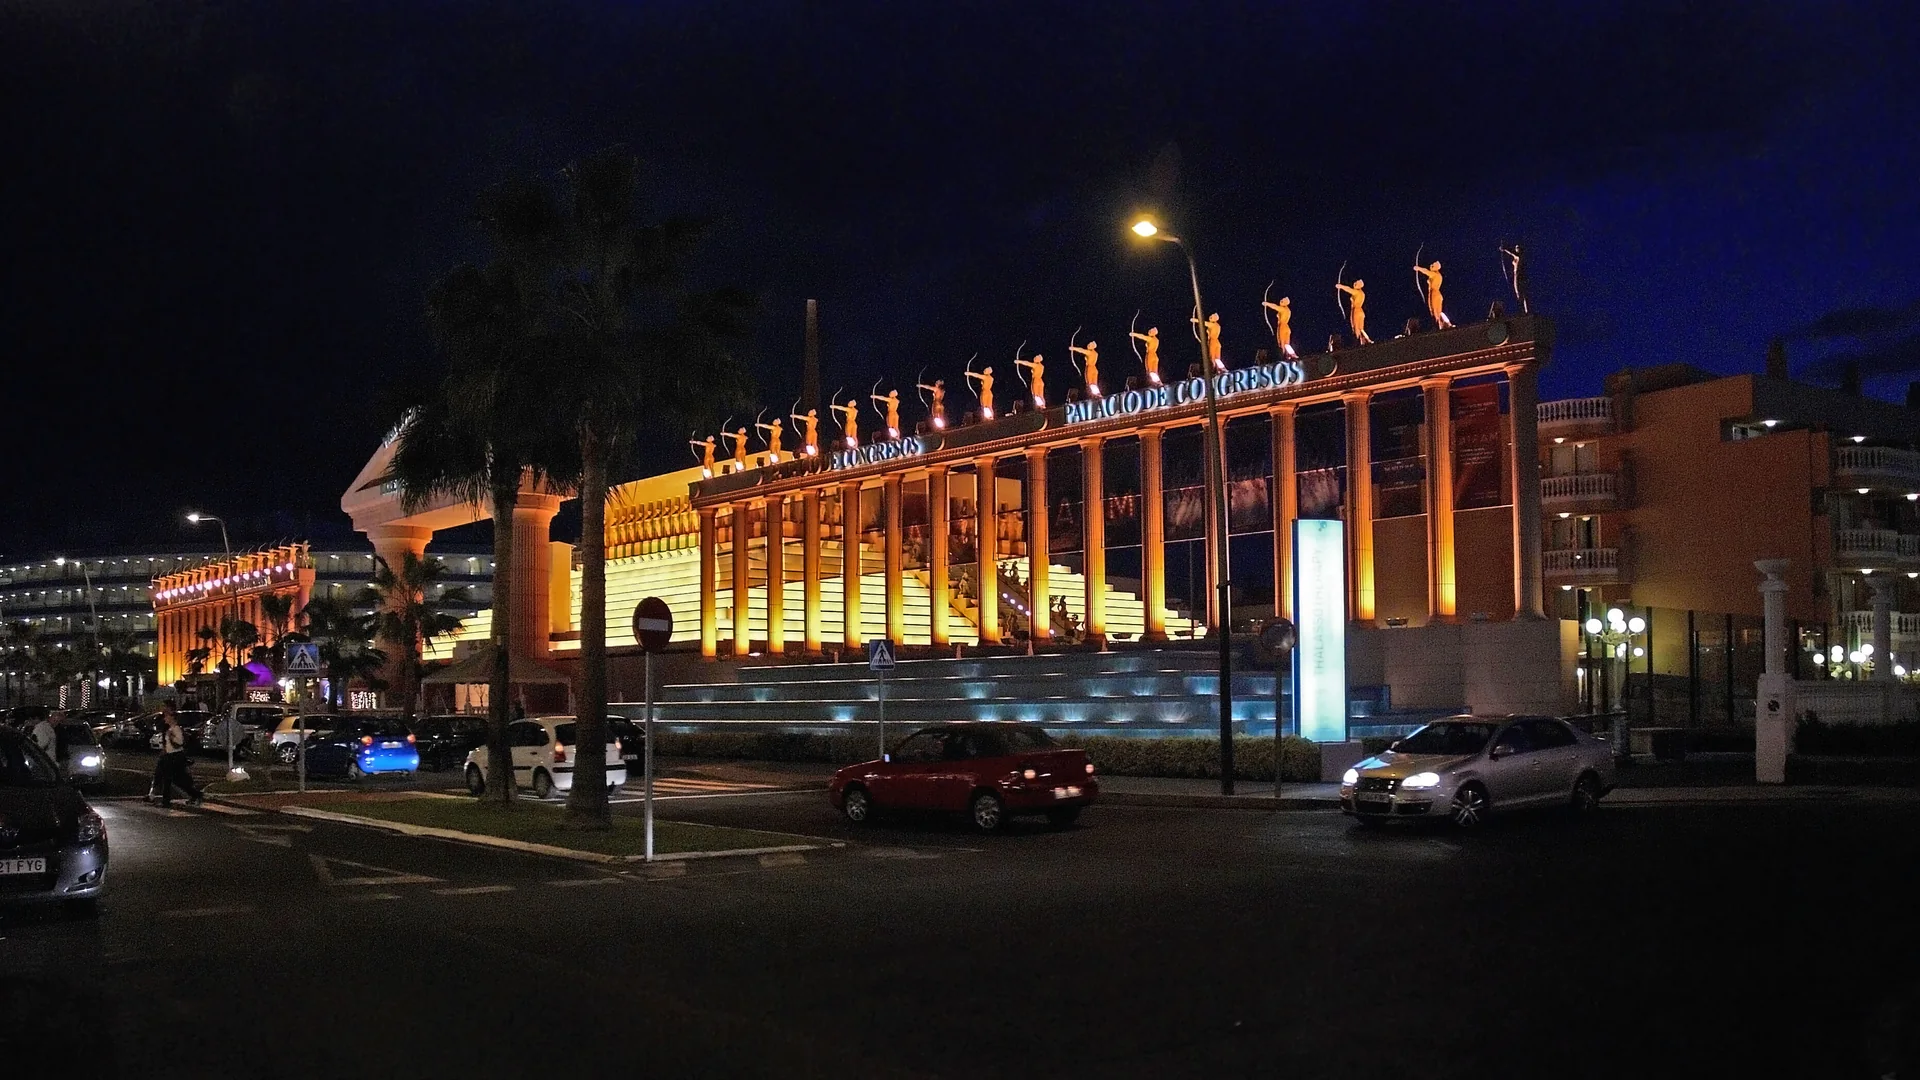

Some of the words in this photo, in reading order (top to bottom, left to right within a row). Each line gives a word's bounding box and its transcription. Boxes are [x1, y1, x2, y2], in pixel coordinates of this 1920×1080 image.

[1064, 391, 1139, 424] PALACIO
[1142, 385, 1167, 409] DE
[1175, 361, 1301, 404] COGRESOS
[841, 437, 920, 468] CONGRESOS
[17, 860, 42, 872] FYG
